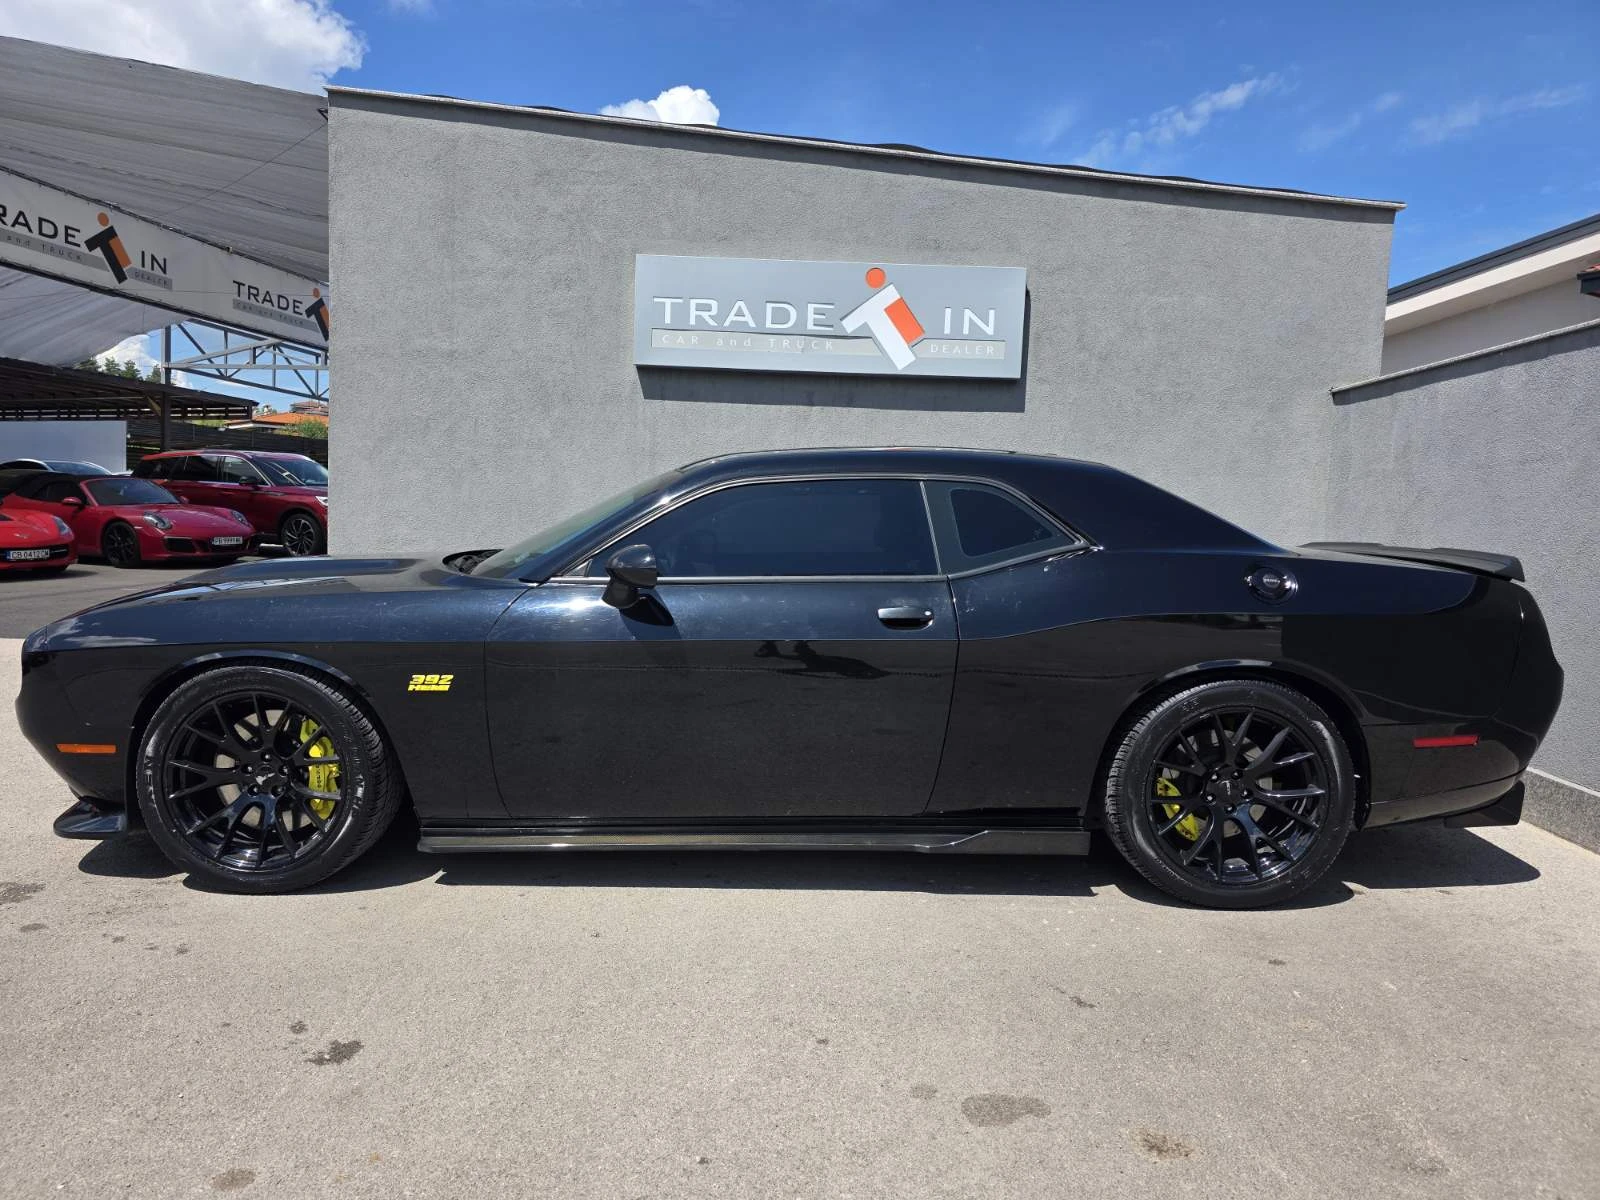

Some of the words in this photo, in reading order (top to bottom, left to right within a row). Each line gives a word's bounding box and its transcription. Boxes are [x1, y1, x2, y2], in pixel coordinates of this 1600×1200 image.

[141, 250, 167, 275] IN
[232, 280, 304, 315] TRADE
[653, 296, 835, 331] TRADE
[944, 307, 996, 336] IN
[661, 334, 699, 345] CAR
[715, 337, 752, 347] and
[767, 338, 833, 350] TRUCK
[930, 344, 995, 356] DEALER
[409, 674, 454, 684] 392
